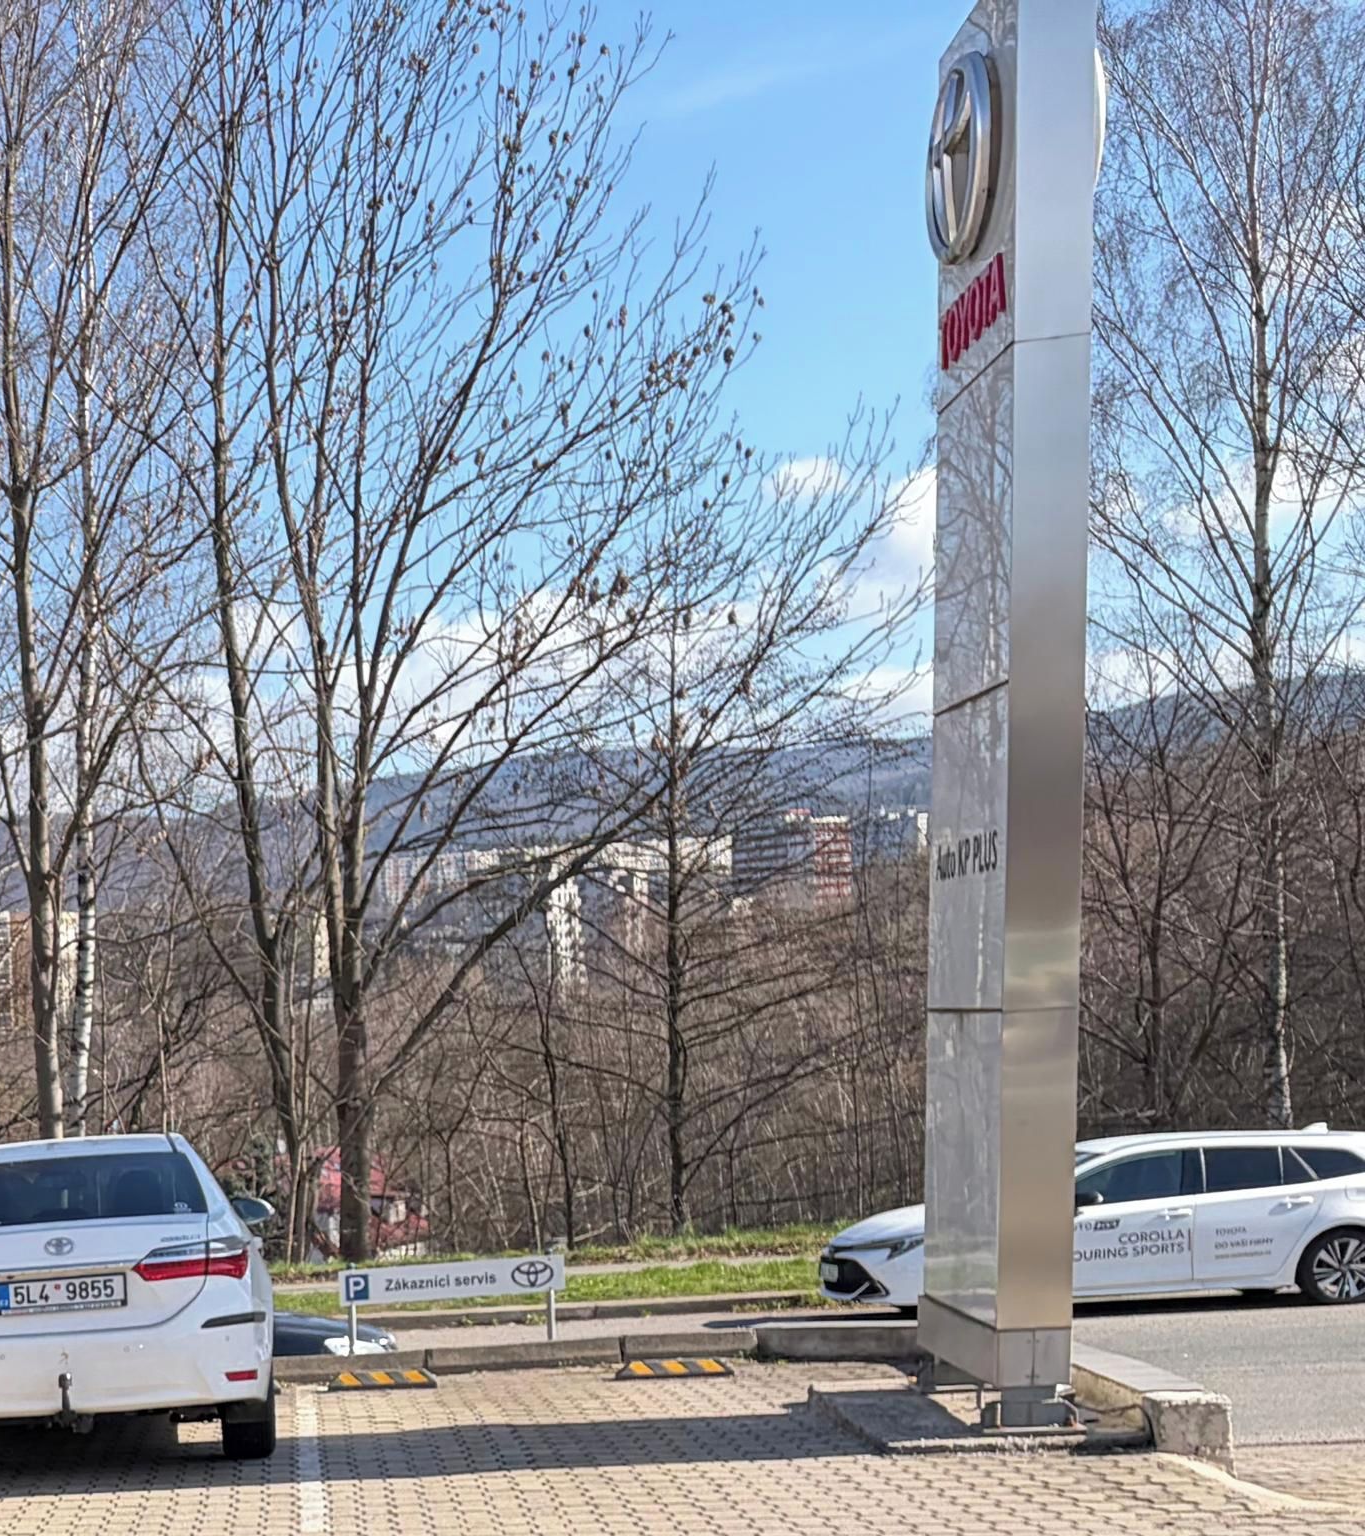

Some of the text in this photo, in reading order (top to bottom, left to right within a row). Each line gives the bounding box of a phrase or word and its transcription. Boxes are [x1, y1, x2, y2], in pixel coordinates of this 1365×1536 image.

[941, 252, 1007, 371] TOYOTA
[972, 829, 998, 874] PLUS
[1117, 1229, 1185, 1246] COROLLA
[1073, 1241, 1185, 1263] OURING SPORTS
[13, 1278, 115, 1306] 5L4 9855
[348, 1276, 366, 1298] P
[455, 1271, 497, 1287] servis
